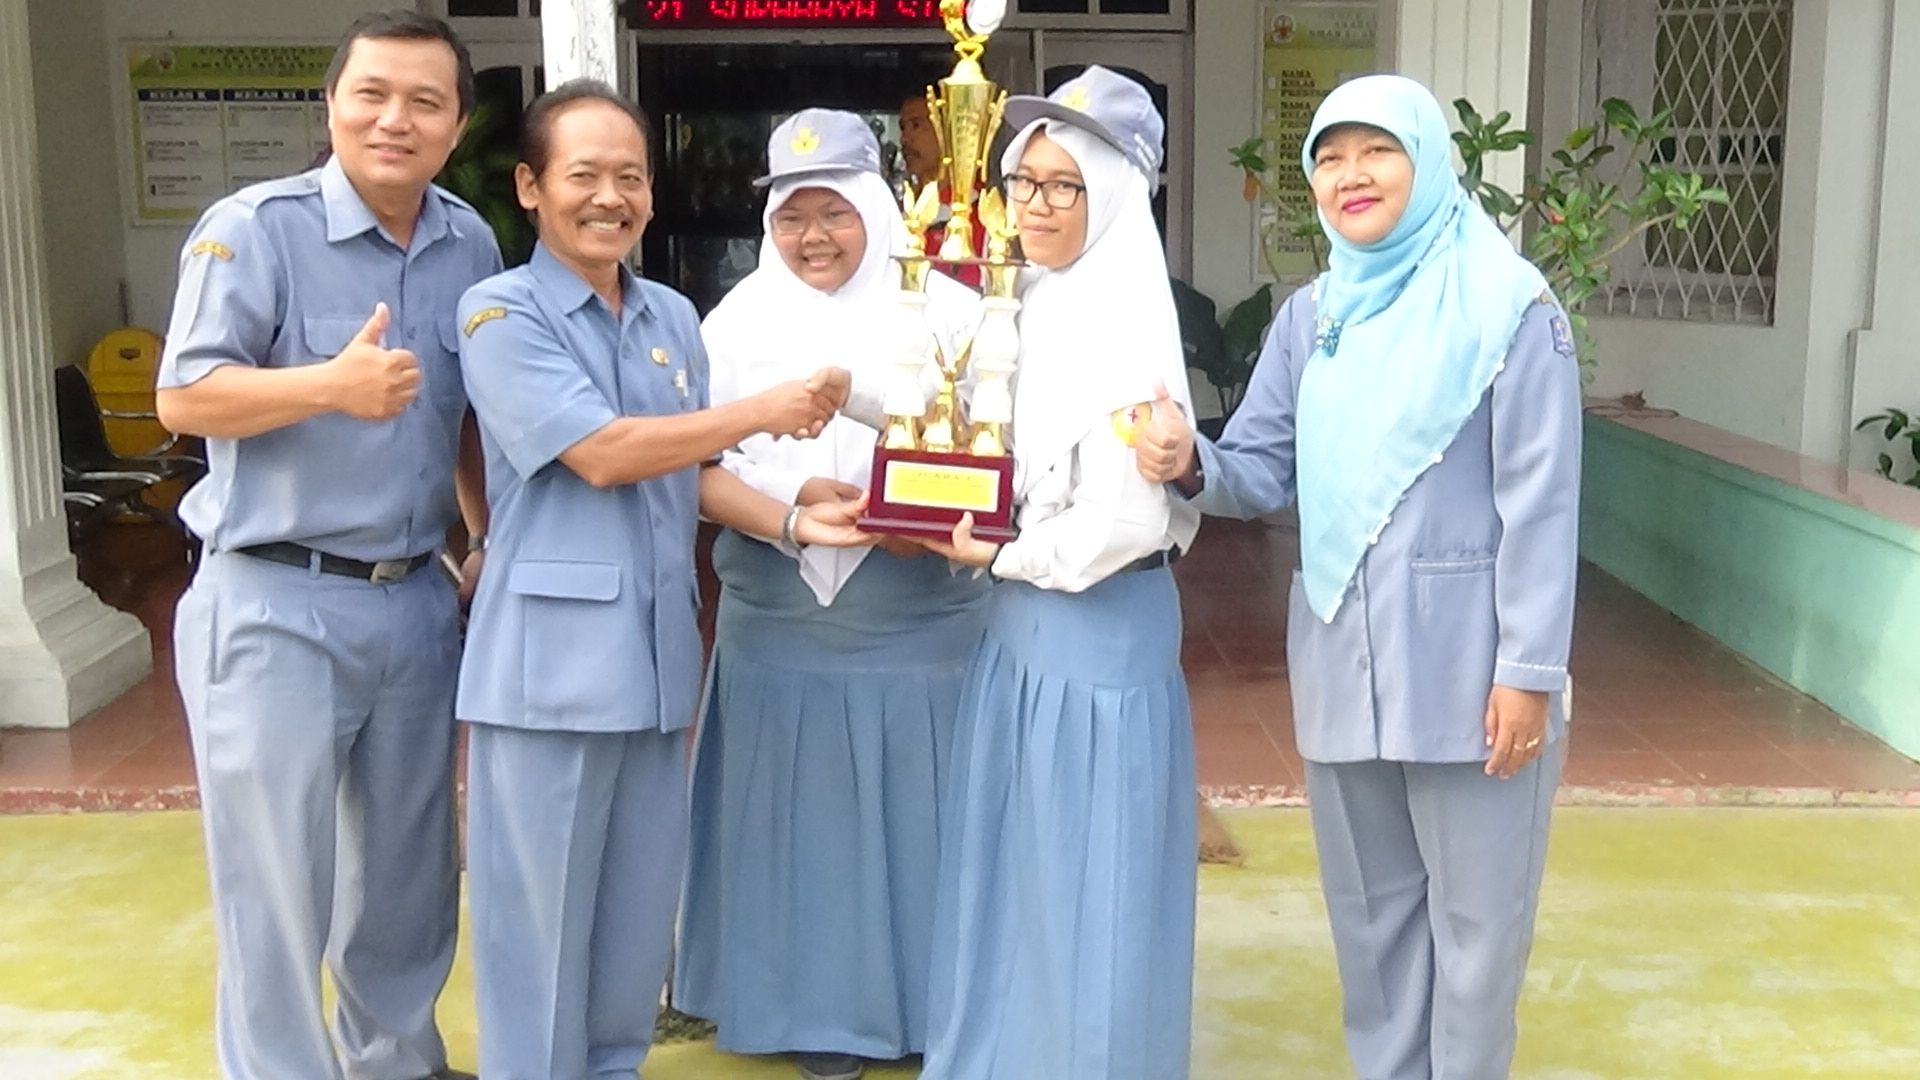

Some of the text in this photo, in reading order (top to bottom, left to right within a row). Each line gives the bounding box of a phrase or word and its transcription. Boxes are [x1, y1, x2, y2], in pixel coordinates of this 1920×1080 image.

[709, 0, 877, 18] SURABAYA
[1281, 70, 1311, 78] NAMA
[1280, 101, 1311, 109] NAMA
